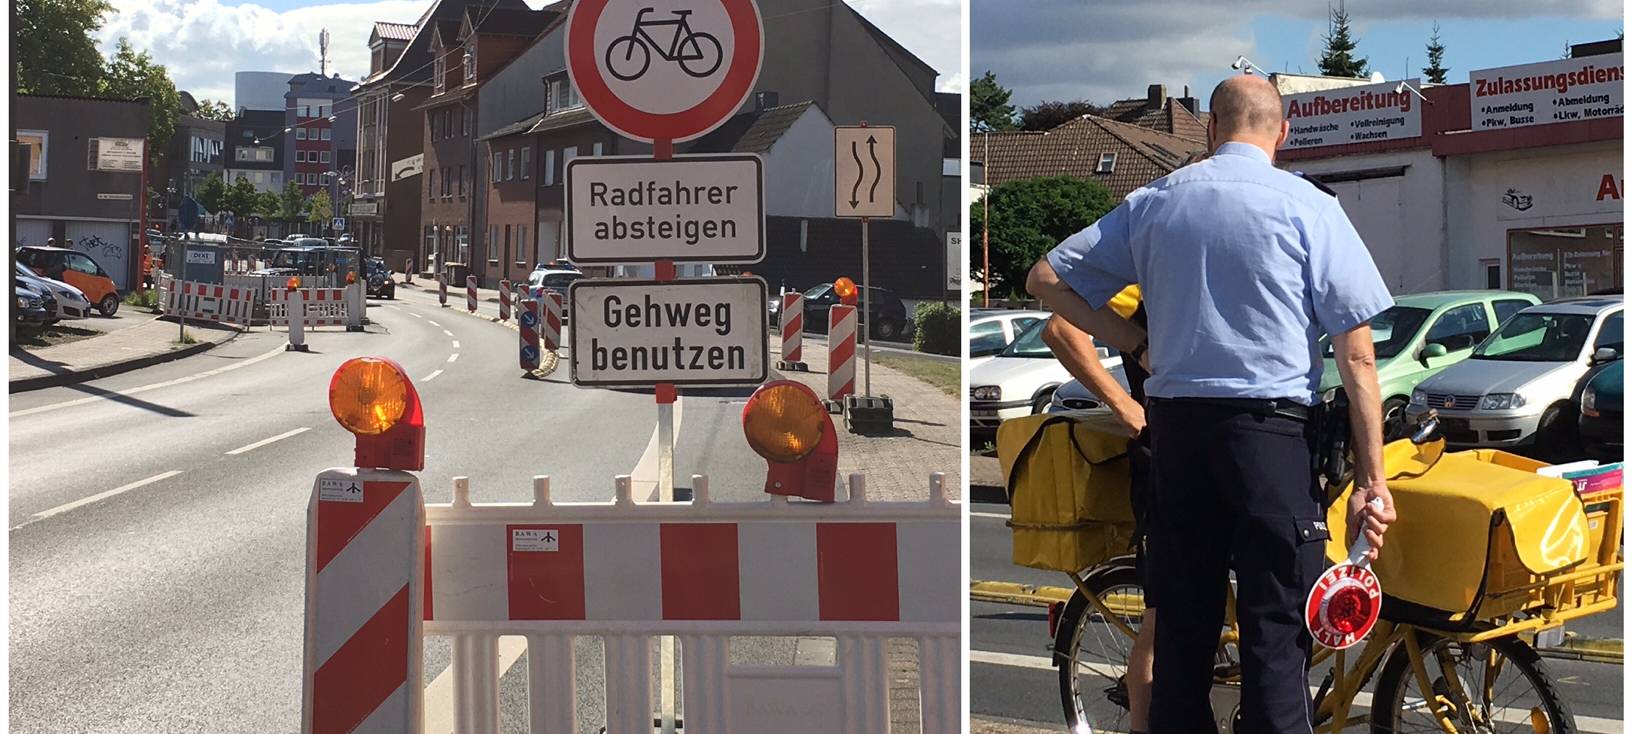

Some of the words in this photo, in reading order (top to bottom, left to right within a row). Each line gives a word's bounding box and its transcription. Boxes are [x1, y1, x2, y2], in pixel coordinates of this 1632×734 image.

[1287, 91, 1411, 119] Aufbereitung
[1485, 102, 1534, 115] Anmeldung
[1558, 94, 1610, 108] Abmeldung
[1354, 117, 1405, 128] Vollreinigung
[1486, 118, 1507, 128] Pkw,
[1509, 115, 1535, 125] Busse
[1559, 111, 1581, 120] Lkw,
[1294, 123, 1339, 135] Handwäsche
[1355, 130, 1388, 140] Wachsen
[1294, 137, 1323, 146] Polieren
[590, 181, 738, 207] Radfahrer
[1596, 174, 1624, 201] A
[594, 214, 737, 245] absteigen
[603, 294, 731, 336] Gehweg
[591, 337, 745, 371] benutzen
[1319, 565, 1380, 600] POLIZEI
[1314, 627, 1356, 646] HALT
